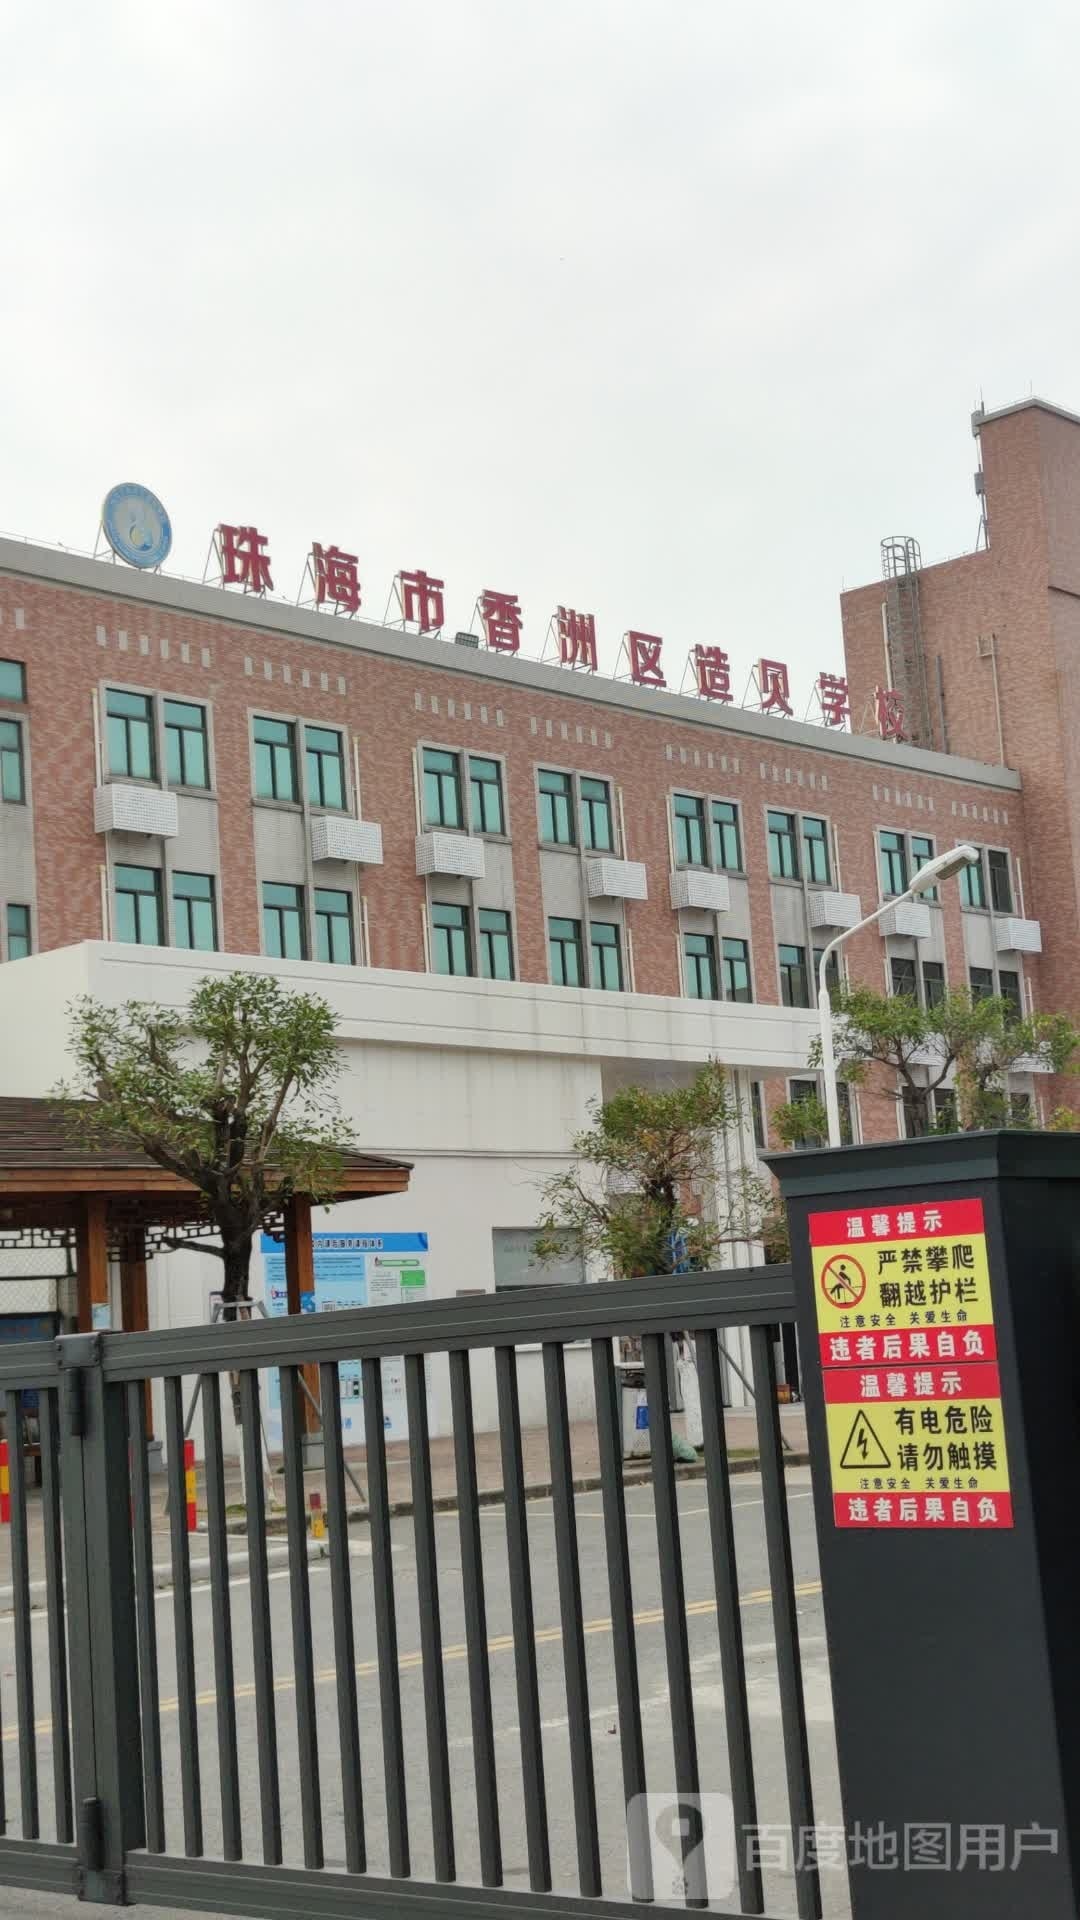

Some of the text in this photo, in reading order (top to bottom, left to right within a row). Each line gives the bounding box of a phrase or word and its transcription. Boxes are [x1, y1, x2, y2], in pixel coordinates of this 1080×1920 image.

[219, 523, 909, 738] 珠海市香洲区造贝学校
[847, 1210, 942, 1238] 温馨提示
[878, 1244, 975, 1275] 严禁攀爬
[880, 1277, 979, 1308] 翻越护栏
[840, 1309, 968, 1328] 注意安全 关爱生命
[830, 1330, 984, 1361] 违者后果自负
[860, 1371, 962, 1398] 温馨提示
[894, 1405, 994, 1435] 有电危险
[897, 1441, 997, 1471] 请勿触摸
[860, 1476, 978, 1489] 注意安全 关爱生命
[848, 1497, 998, 1522] 违者后果自负
